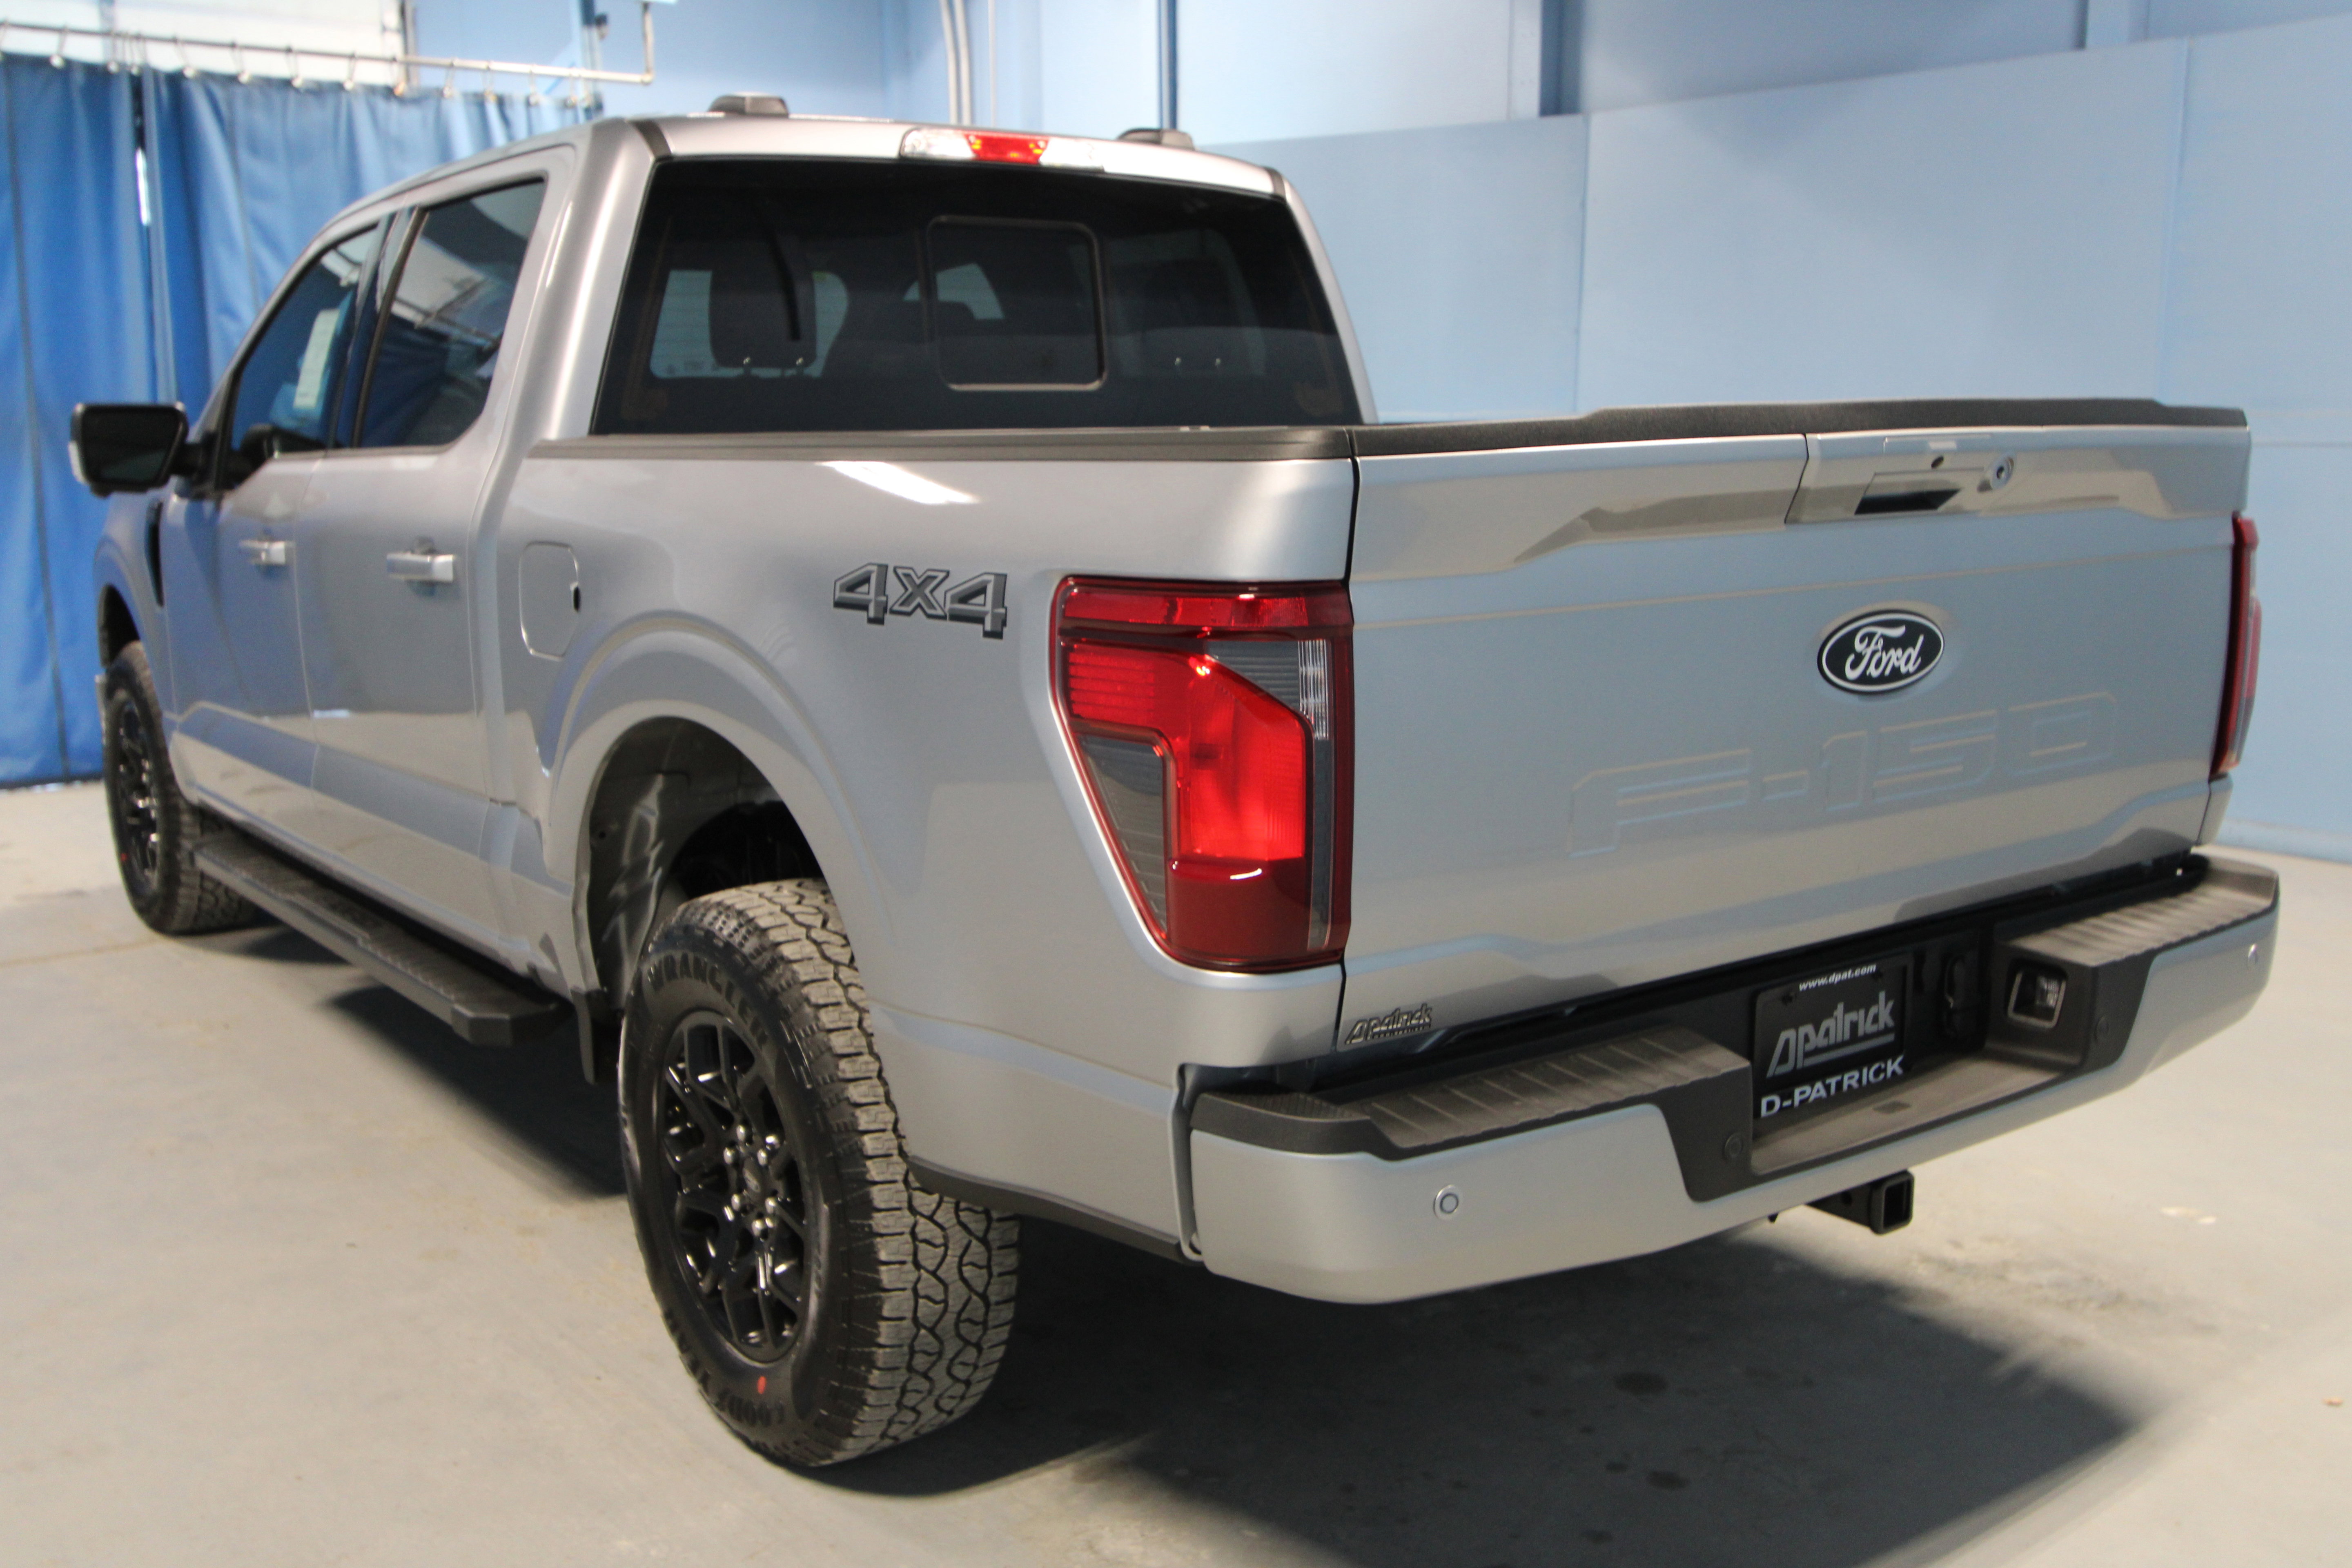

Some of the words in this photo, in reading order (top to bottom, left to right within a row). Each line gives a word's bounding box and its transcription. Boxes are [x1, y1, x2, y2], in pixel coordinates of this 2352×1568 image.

[1845, 624, 1924, 681] Ford
[1567, 690, 2119, 859] F-150
[1799, 963, 1877, 992] www.dpat.com
[1760, 1055, 1904, 1118] D-PATRICK
